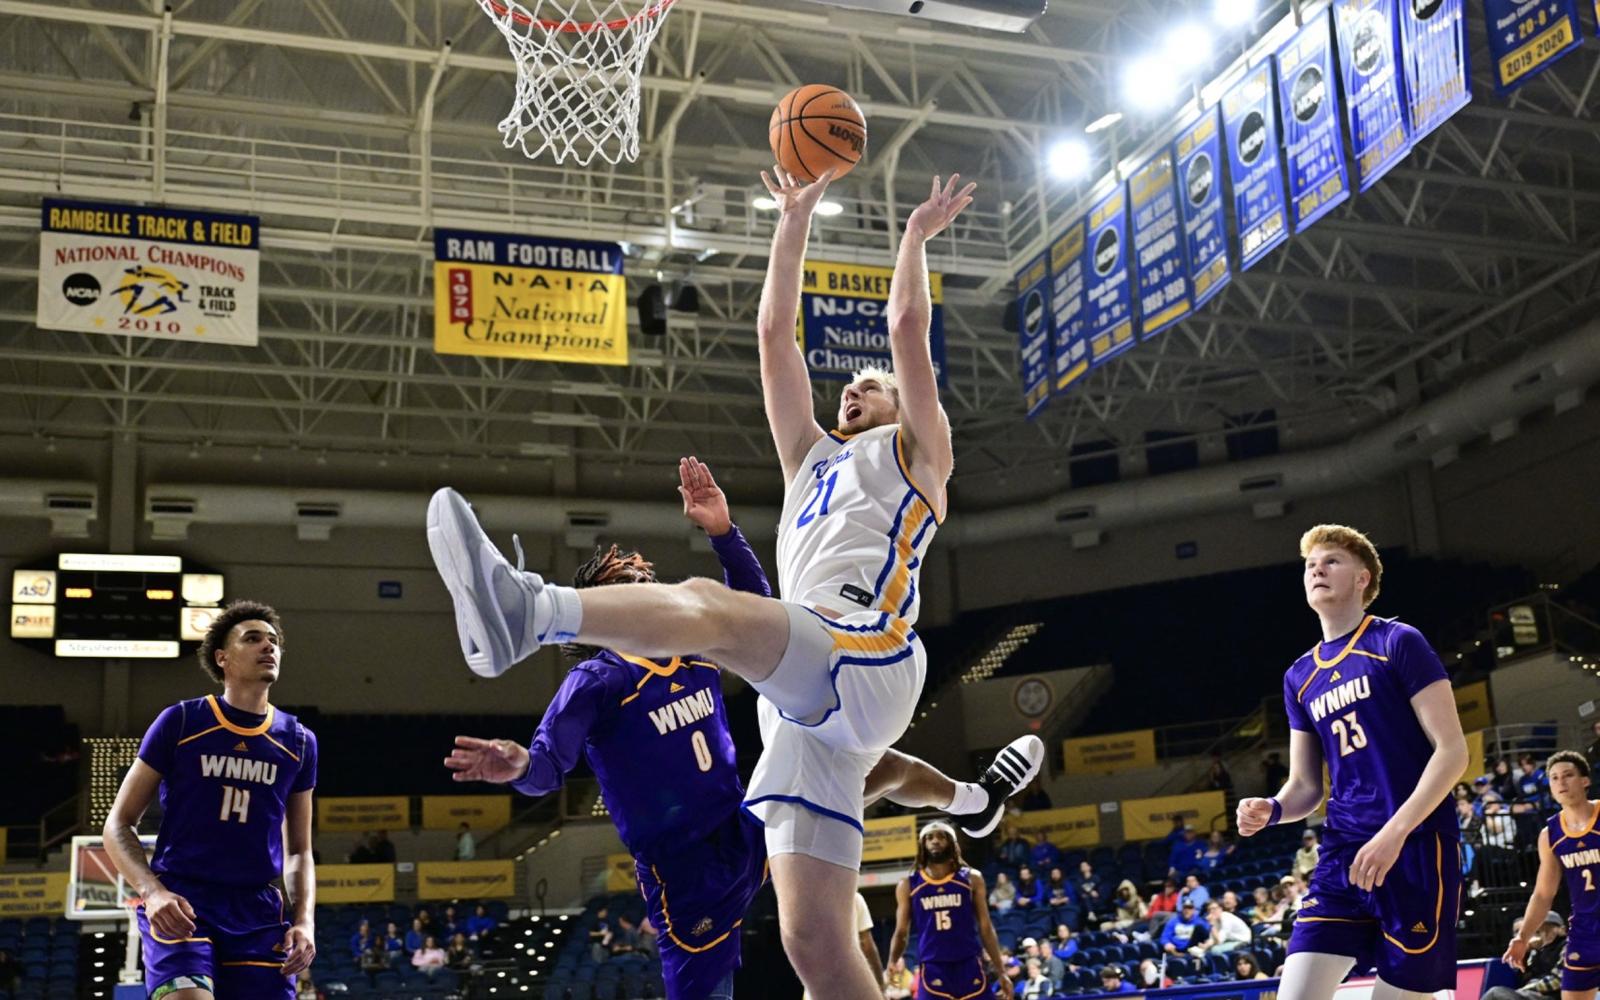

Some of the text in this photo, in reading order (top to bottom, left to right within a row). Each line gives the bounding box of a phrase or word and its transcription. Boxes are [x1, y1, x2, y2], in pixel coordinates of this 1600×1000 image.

[1497, 12, 1517, 30] South
[49, 207, 252, 246] RAMBELLE TRACK & FIELD
[55, 245, 245, 282] NATIONAL CHAMPIONS
[447, 238, 614, 272] RAM FOOTBALL
[66, 287, 100, 300] NCAA
[198, 286, 235, 299] TRACK
[198, 298, 236, 313] & FIELD
[118, 317, 181, 334] 2010
[490, 296, 608, 325] National
[463, 318, 614, 352] Champions
[797, 470, 838, 529] 21
[648, 687, 714, 735] WNMU
[1309, 675, 1371, 722] WNMU
[1331, 710, 1368, 757] 23
[691, 730, 713, 773] 0
[200, 754, 278, 786] WNMU
[220, 784, 251, 823] 14
[1581, 869, 1596, 891] 2
[920, 893, 962, 911] WNMU
[934, 910, 952, 931] 15
